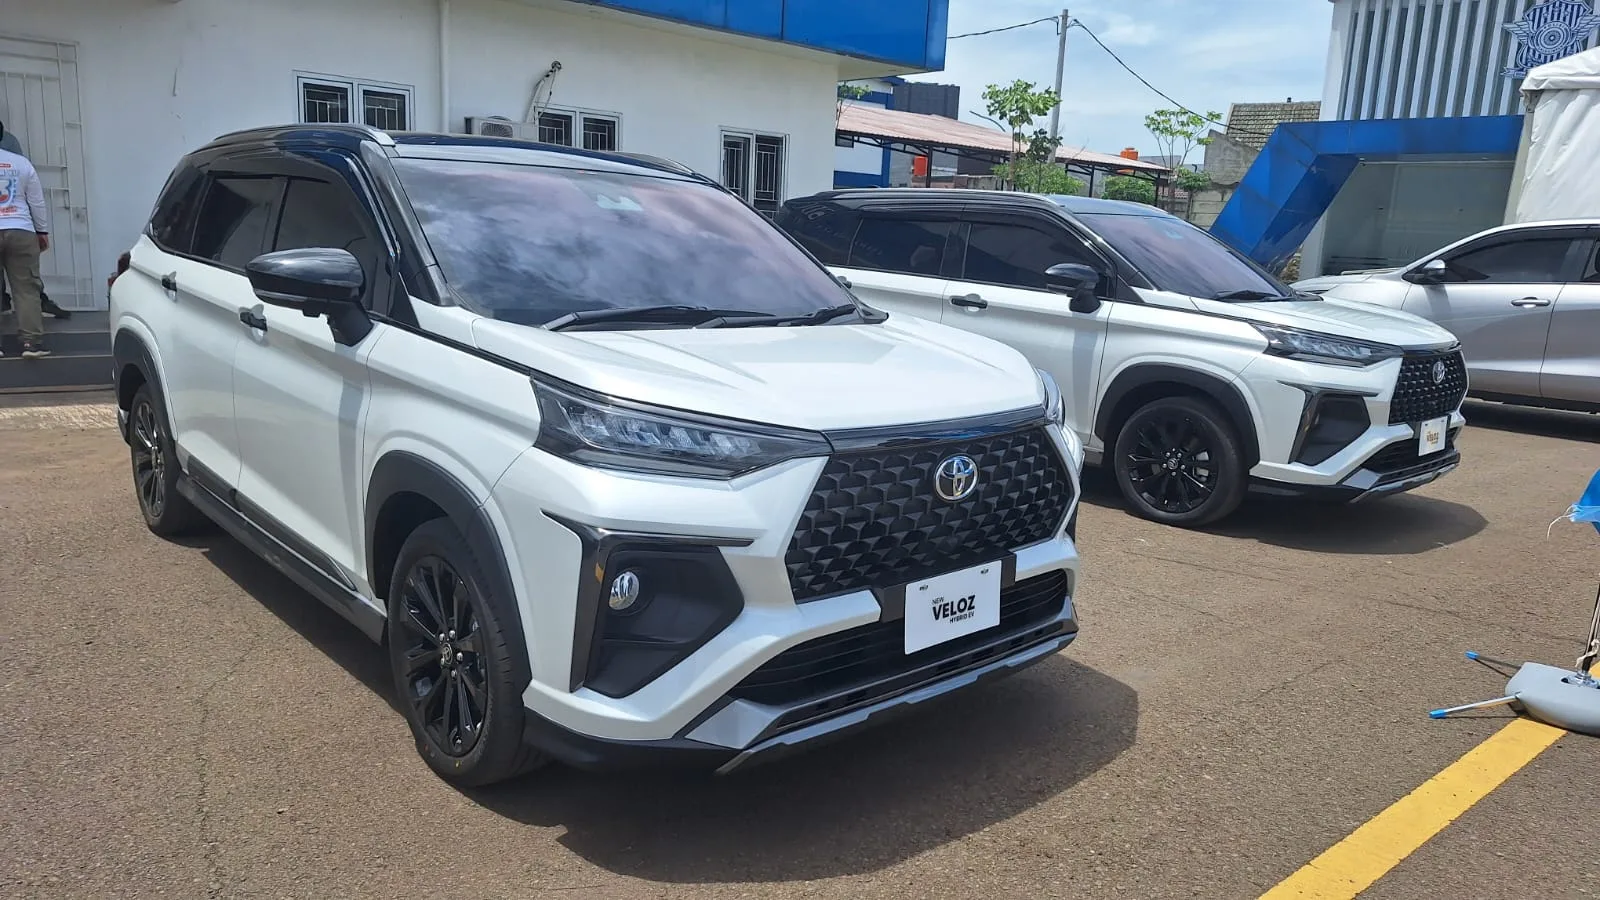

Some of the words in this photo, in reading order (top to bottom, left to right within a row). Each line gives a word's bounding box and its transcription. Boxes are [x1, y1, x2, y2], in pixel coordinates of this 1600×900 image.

[932, 595, 976, 620] VELOZ
[949, 614, 967, 624] HYBRID
[968, 611, 975, 619] EV
